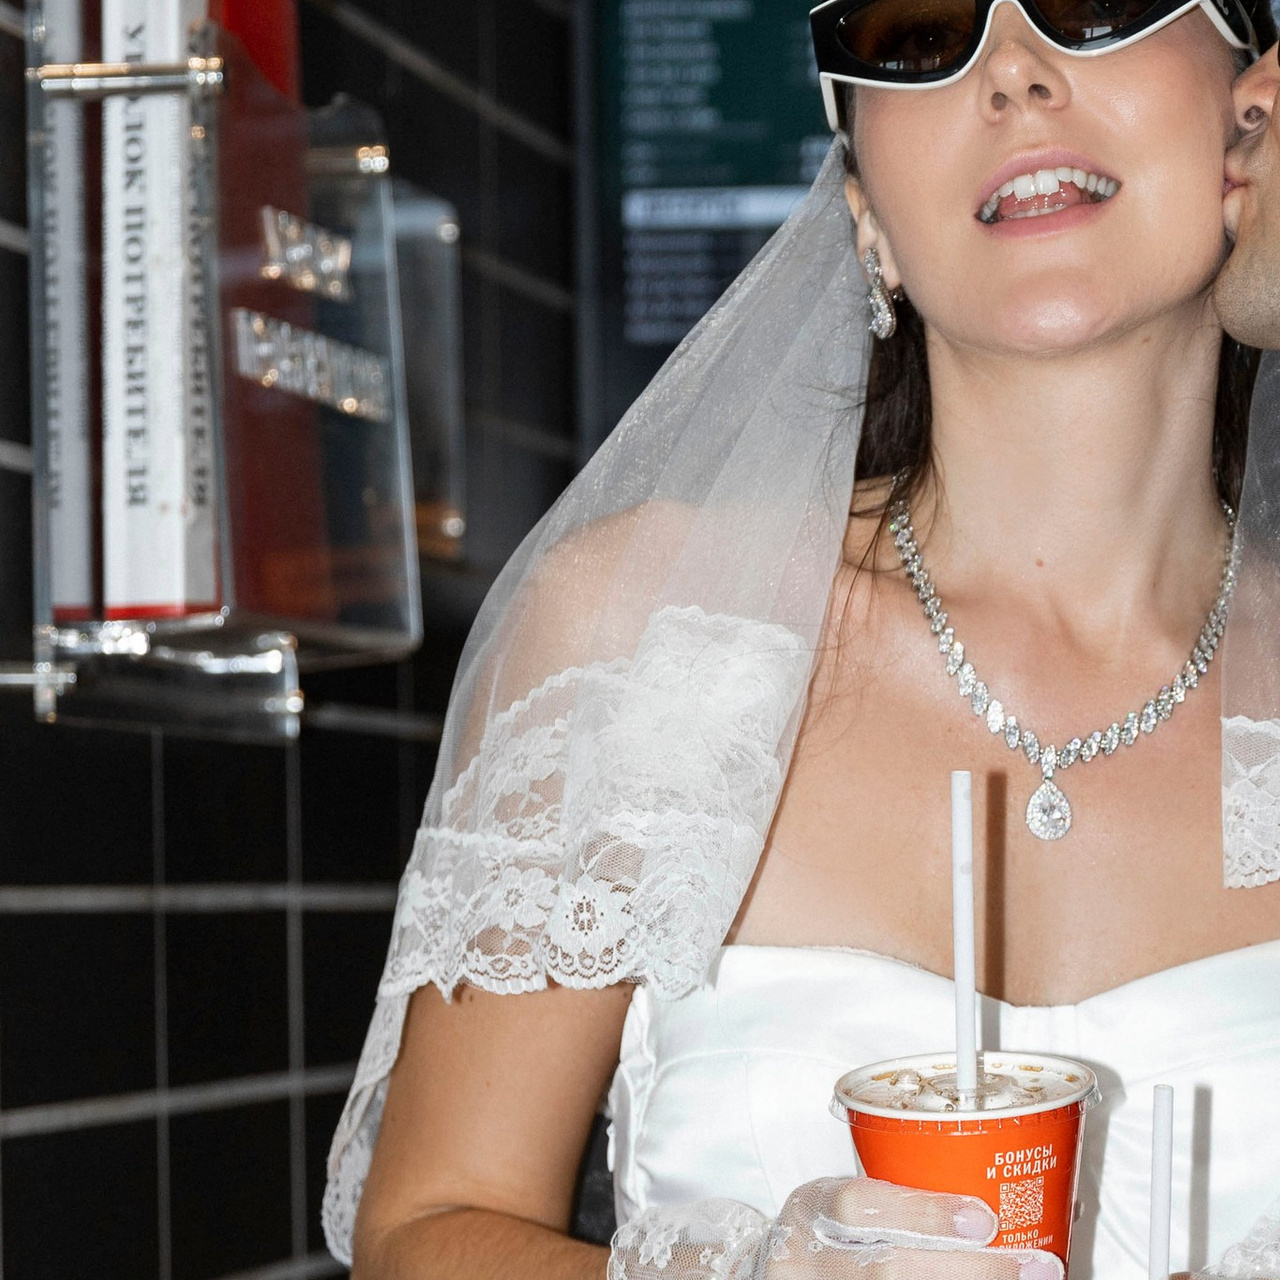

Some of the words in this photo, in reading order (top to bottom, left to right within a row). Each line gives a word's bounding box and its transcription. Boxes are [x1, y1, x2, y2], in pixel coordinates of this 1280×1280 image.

[121, 205, 148, 508] ПОТРЕБИТЕЛЯ
[994, 1143, 1053, 1166] БОНУСЫ
[986, 1166, 997, 1180] И
[1002, 1155, 1057, 1178] СКИДКИ
[1002, 1228, 1039, 1244] ТОЛЬКО
